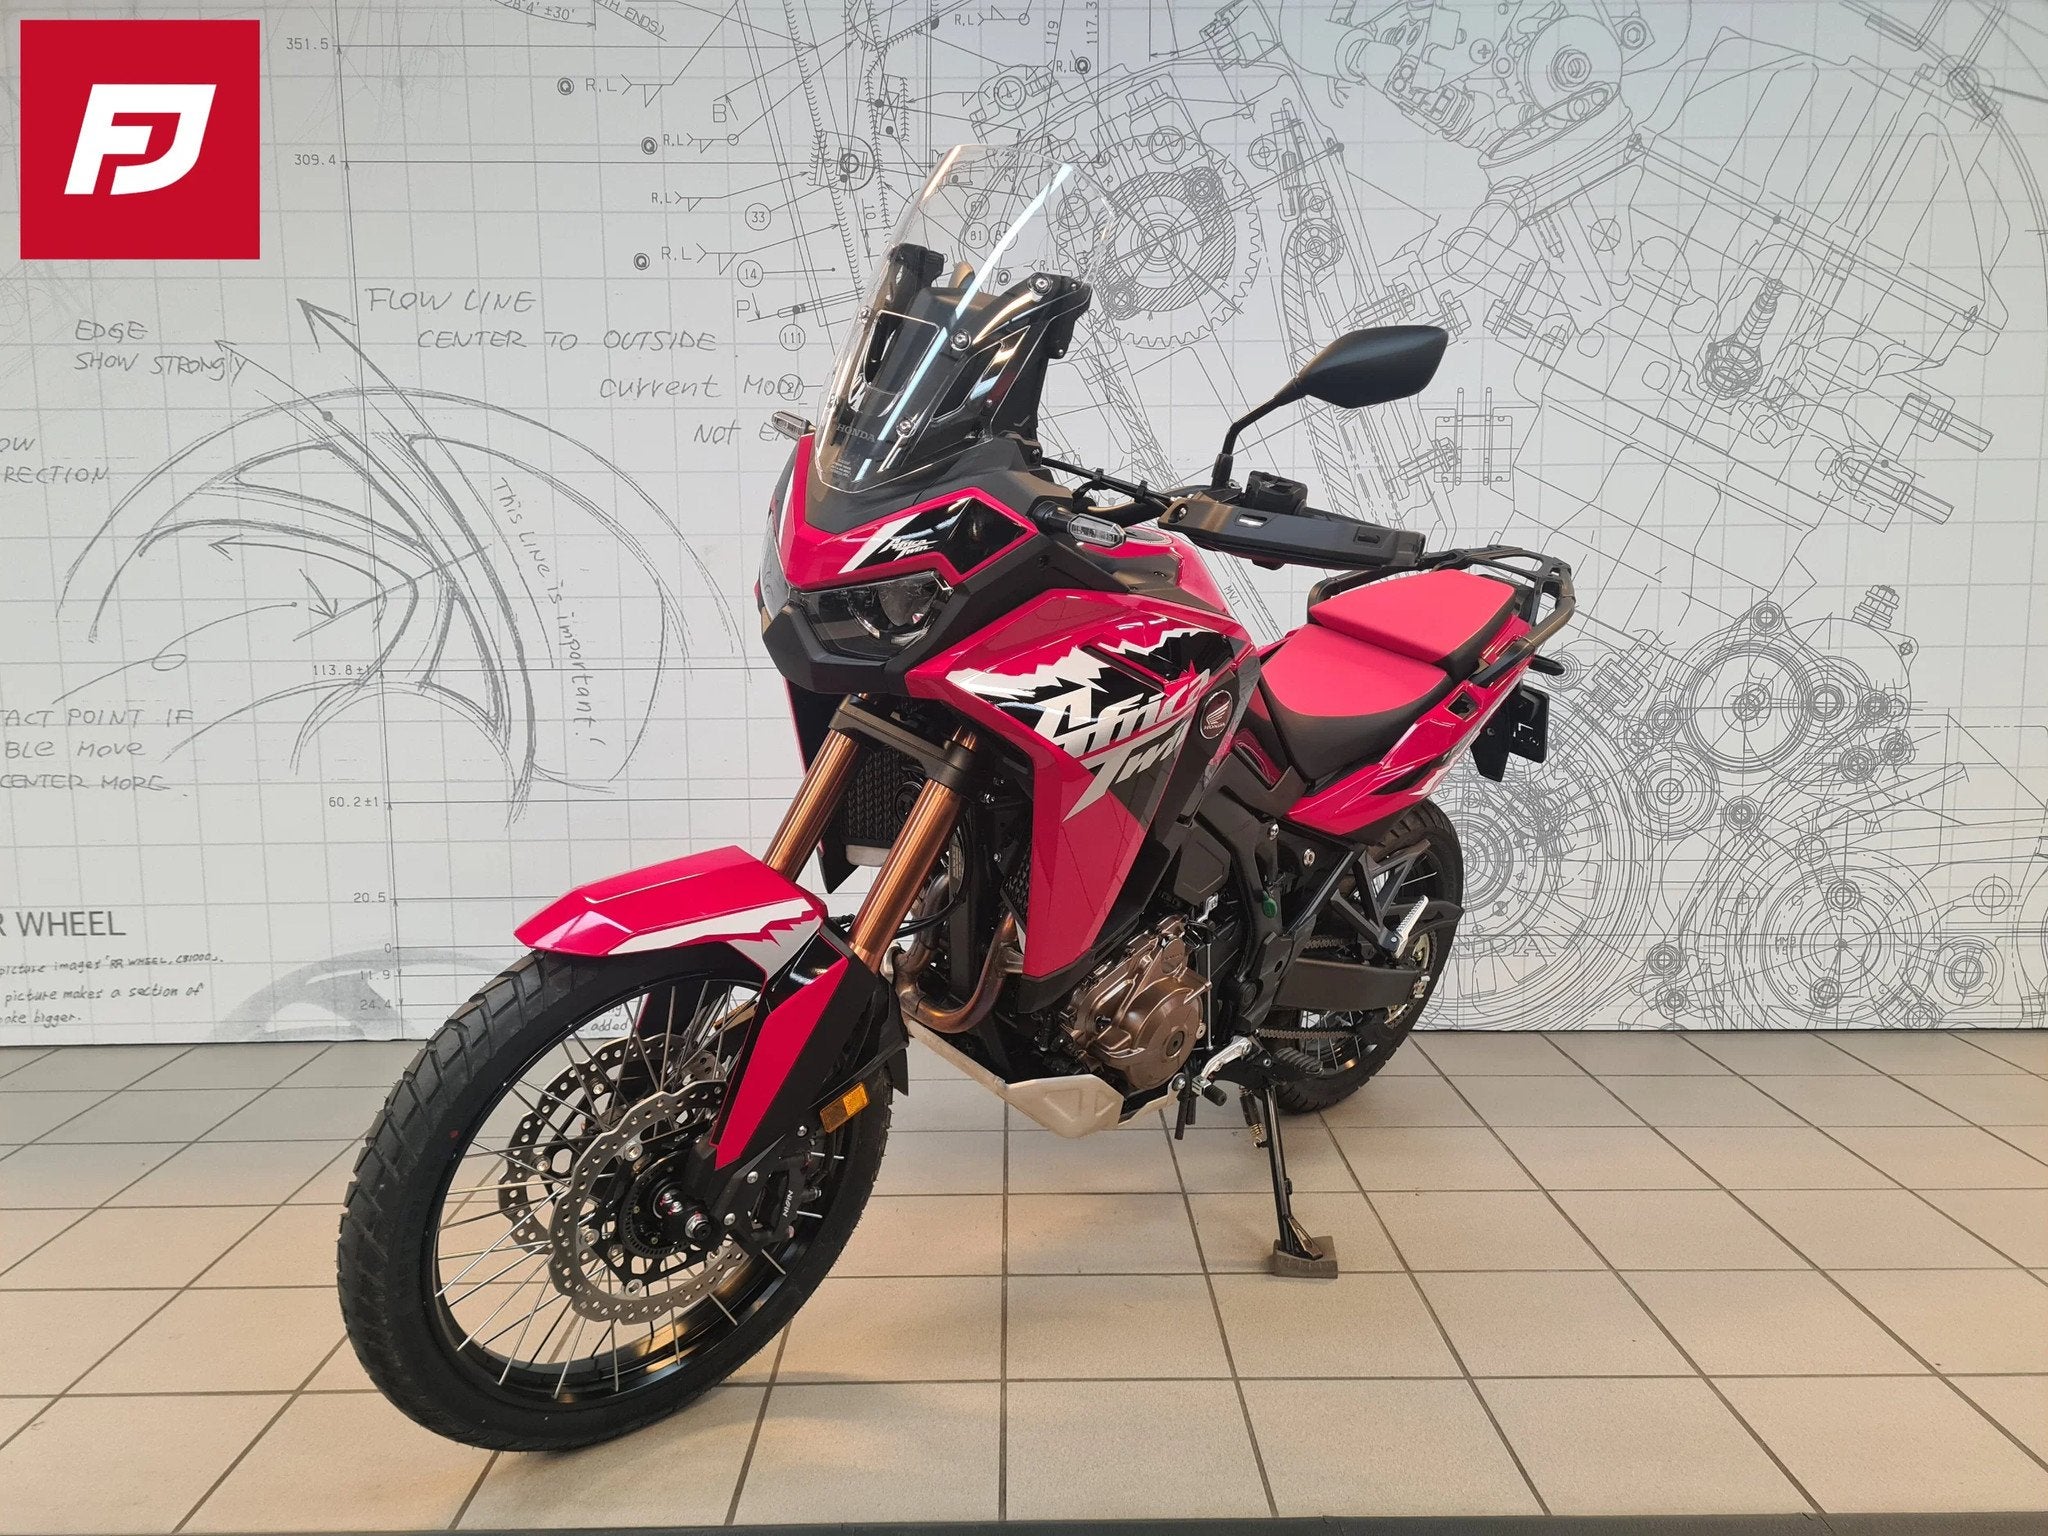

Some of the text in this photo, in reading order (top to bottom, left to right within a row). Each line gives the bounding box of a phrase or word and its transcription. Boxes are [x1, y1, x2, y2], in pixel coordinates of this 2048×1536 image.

[286, 37, 329, 50] 351.5
[712, 103, 727, 123] B
[294, 153, 336, 165] 309.4
[751, 211, 766, 223] 33
[745, 268, 757, 280] 14
[365, 287, 537, 314] FLOW LINE
[737, 300, 751, 318] P
[75, 319, 149, 343] EDGE
[783, 332, 801, 344] 111
[417, 330, 717, 351] CENTER TO OUTSIDE
[74, 351, 140, 371] SHOW
[836, 423, 877, 442] HONDA
[4, 465, 109, 485] RECTION
[67, 708, 145, 728] POINT
[166, 708, 194, 727] IF
[0, 774, 89, 791] CENTER
[353, 891, 387, 903] 20.5
[15, 910, 127, 937] WHEEL
[360, 969, 391, 980] 11.9
[4, 989, 58, 1007] picture
[110, 987, 121, 998] a
[360, 999, 392, 1011] 24.4
[590, 1018, 631, 1032] added
